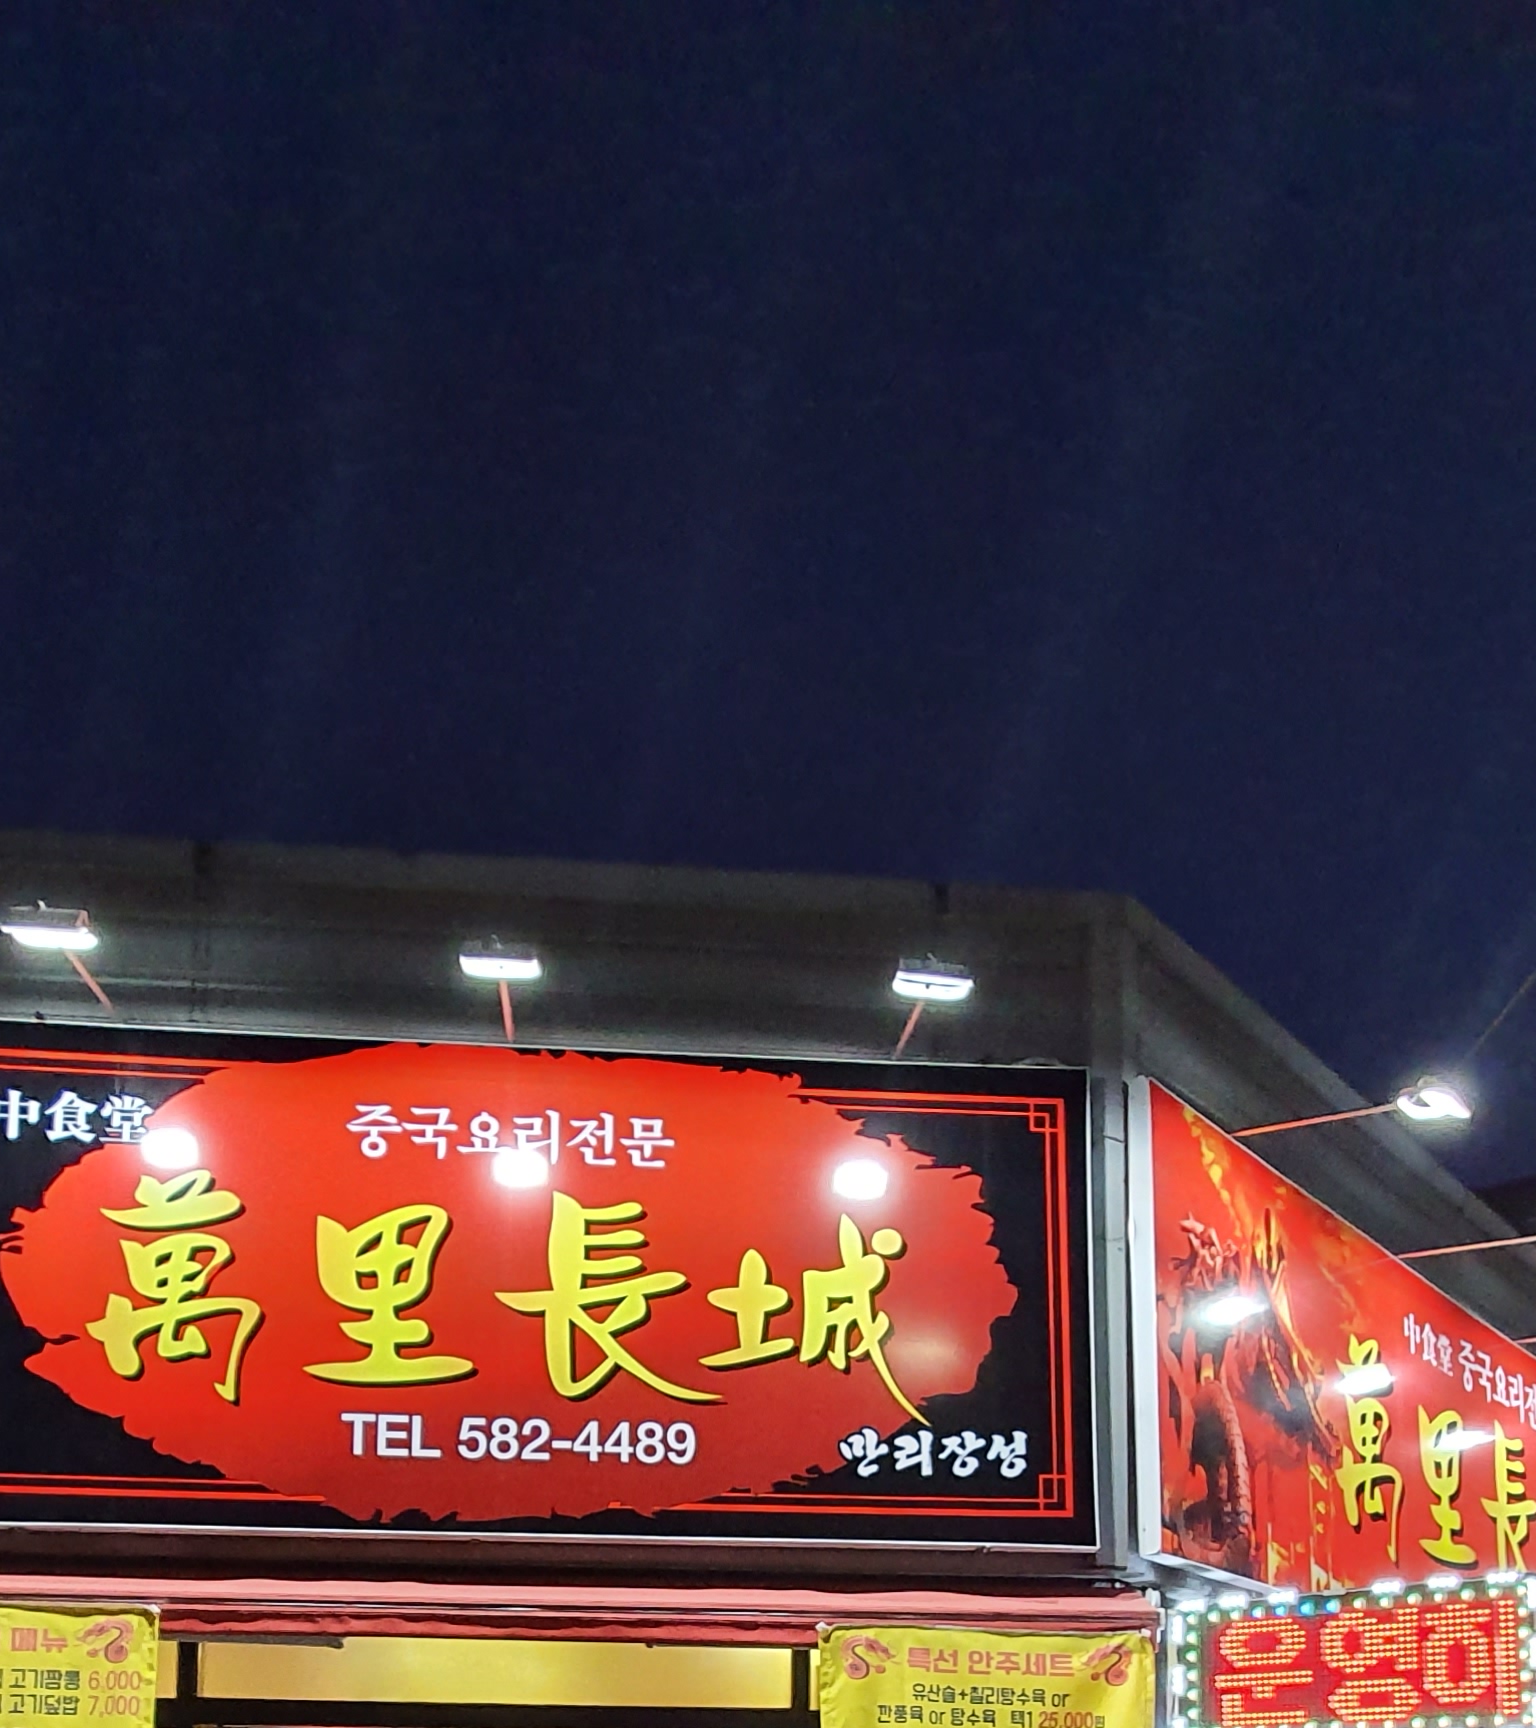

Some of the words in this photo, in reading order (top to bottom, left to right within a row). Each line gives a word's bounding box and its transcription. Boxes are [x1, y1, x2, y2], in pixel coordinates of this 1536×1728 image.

[344, 1100, 677, 1170] 중국요리전문
[84, 1172, 930, 1425] 萬里長城
[341, 1411, 443, 1461] TEL
[456, 1412, 697, 1467] 582-4489
[836, 1428, 1029, 1480] 만리장성
[10, 1627, 69, 1653] 메뉴
[907, 1647, 959, 1674] 특선
[967, 1650, 1075, 1677] 안주세트
[9, 1668, 81, 1690] 고기짬뽕
[88, 1670, 142, 1692] 6,000
[8, 1693, 81, 1715] 고기덮밥
[87, 1695, 141, 1718] 7,000
[1051, 1693, 1071, 1708] or
[877, 1704, 923, 1724] 깐풍육
[929, 1710, 946, 1725] or
[950, 1708, 996, 1727] 탕수육
